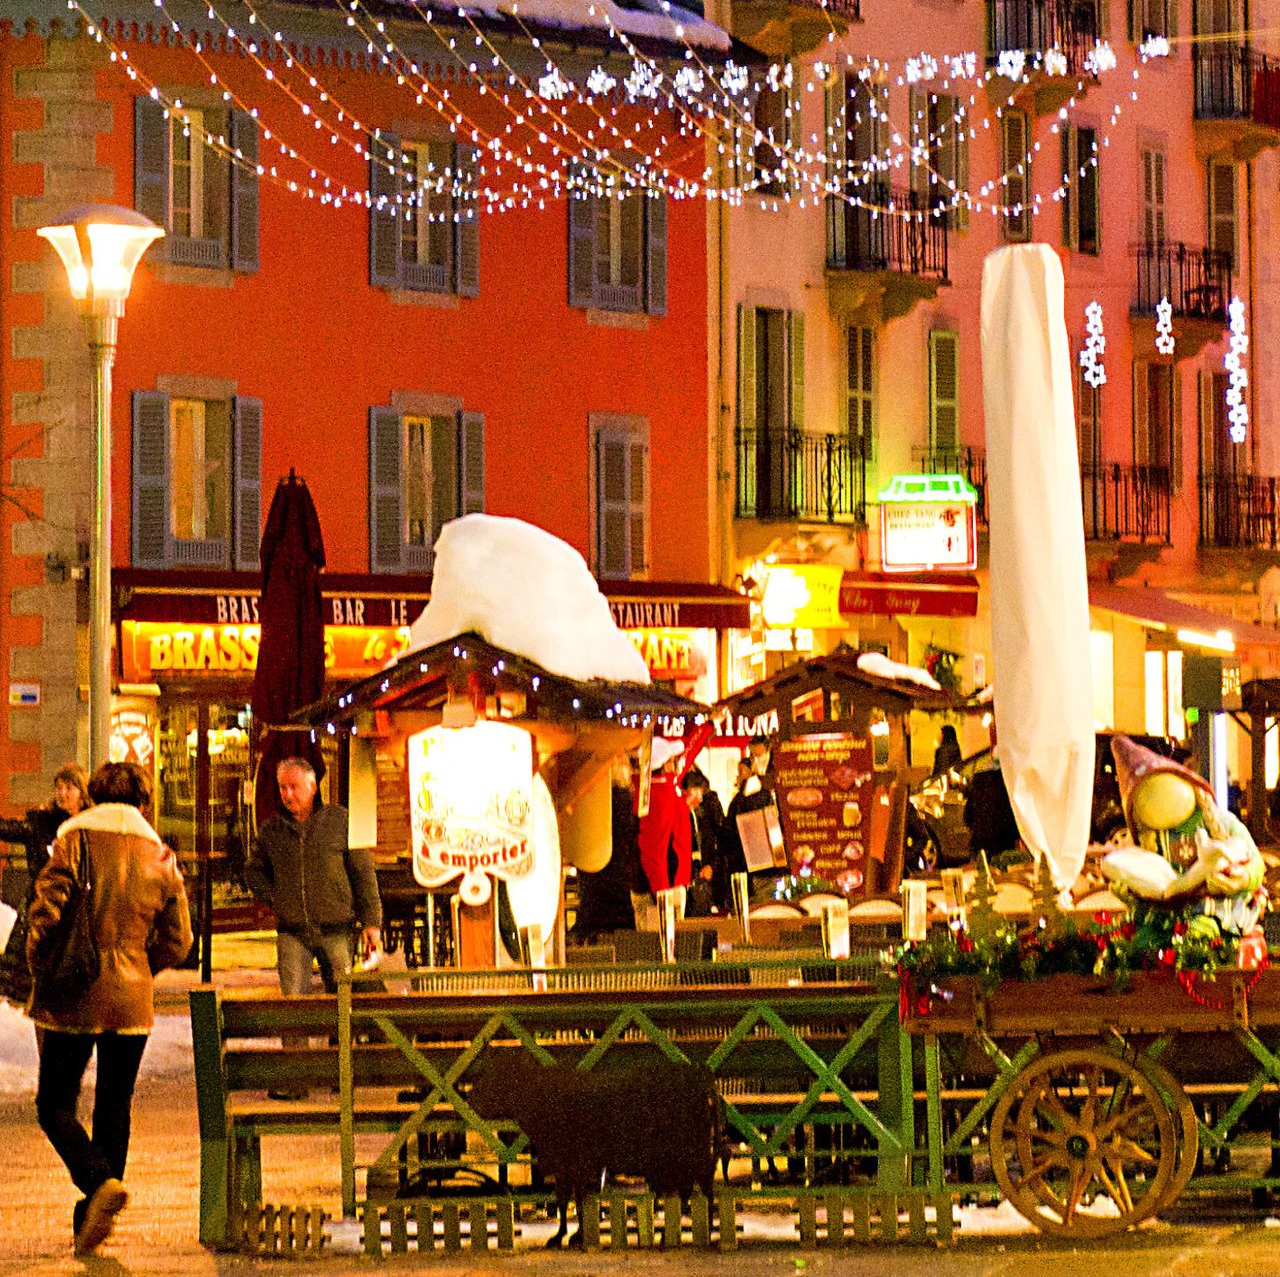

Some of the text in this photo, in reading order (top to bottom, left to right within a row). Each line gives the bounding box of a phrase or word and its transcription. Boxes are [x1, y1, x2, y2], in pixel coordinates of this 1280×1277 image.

[332, 598, 365, 625] BAR
[391, 600, 407, 625] LE
[439, 837, 528, 873] emporter
